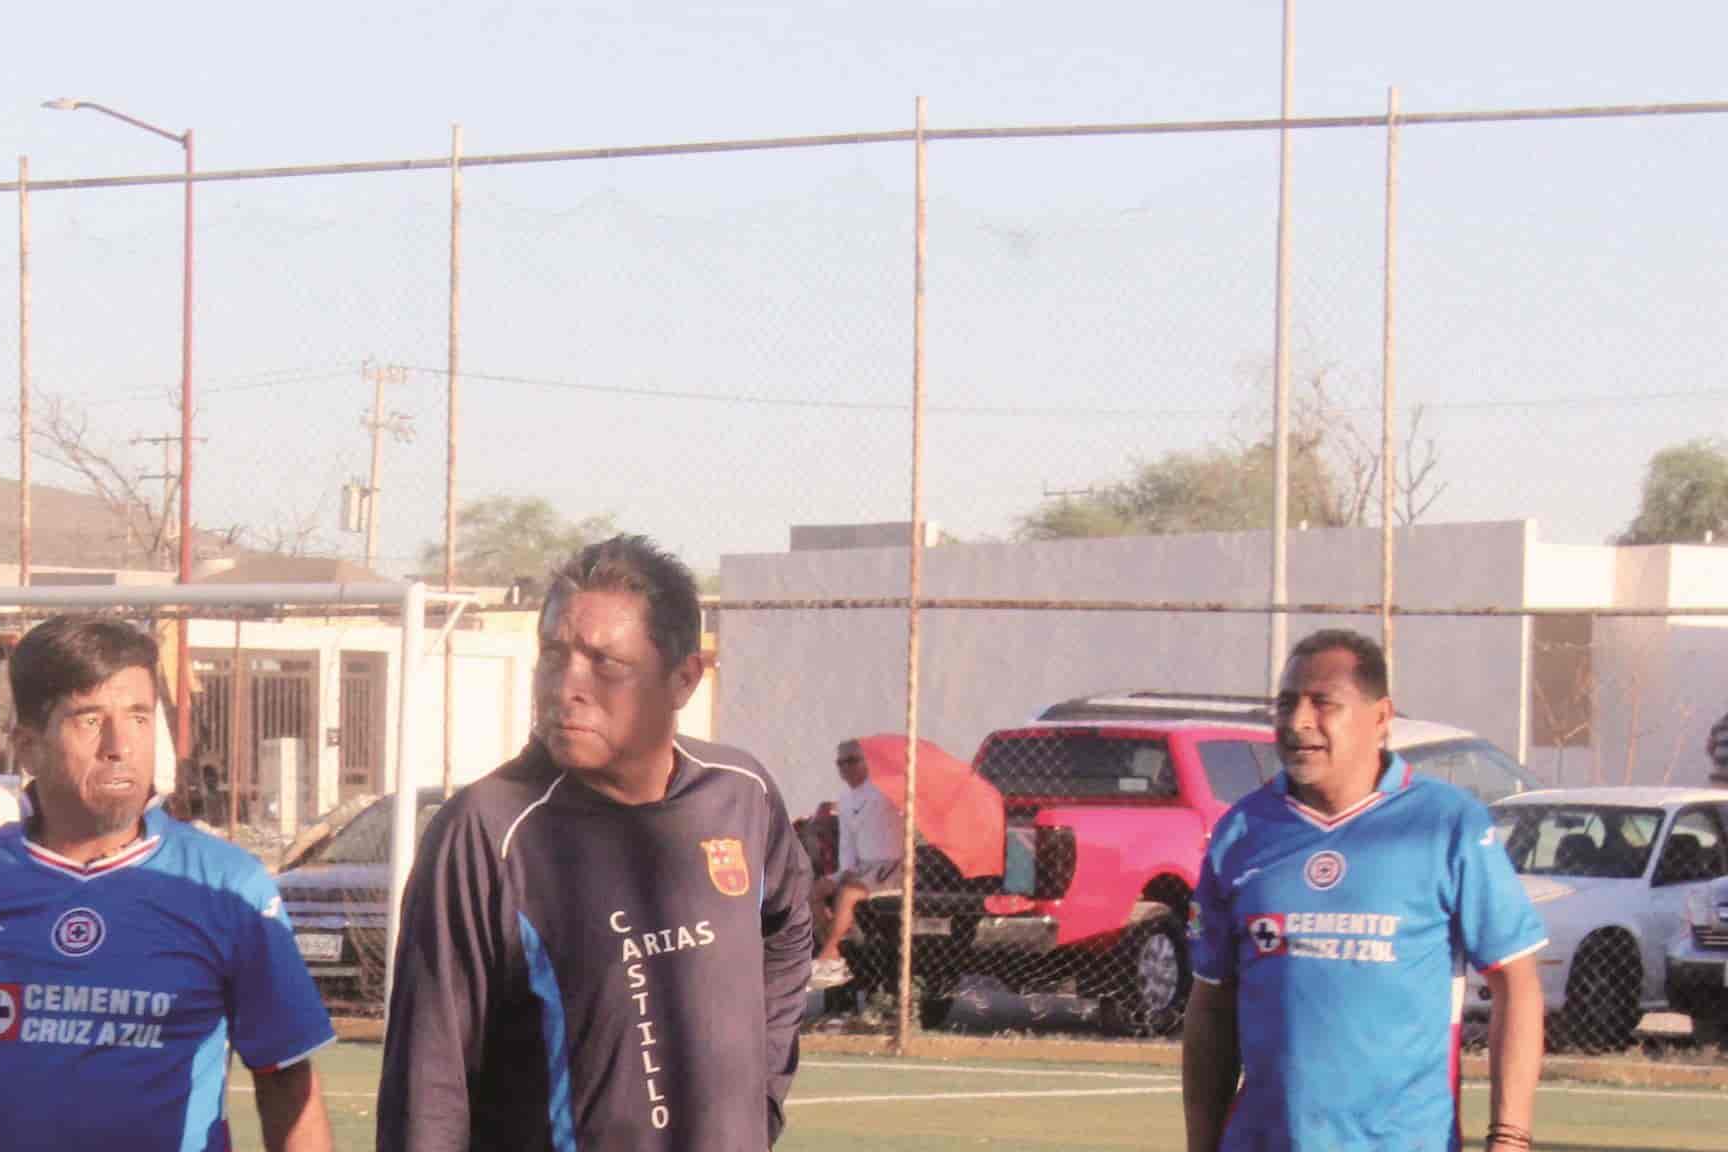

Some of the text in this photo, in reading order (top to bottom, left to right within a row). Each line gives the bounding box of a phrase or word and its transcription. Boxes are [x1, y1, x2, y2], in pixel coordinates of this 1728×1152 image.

[621, 920, 716, 963] ARIAS
[1287, 913, 1399, 937] CEMENTO
[23, 984, 172, 1017] CEMENTO
[21, 1016, 164, 1049] CRUZ AZUL
